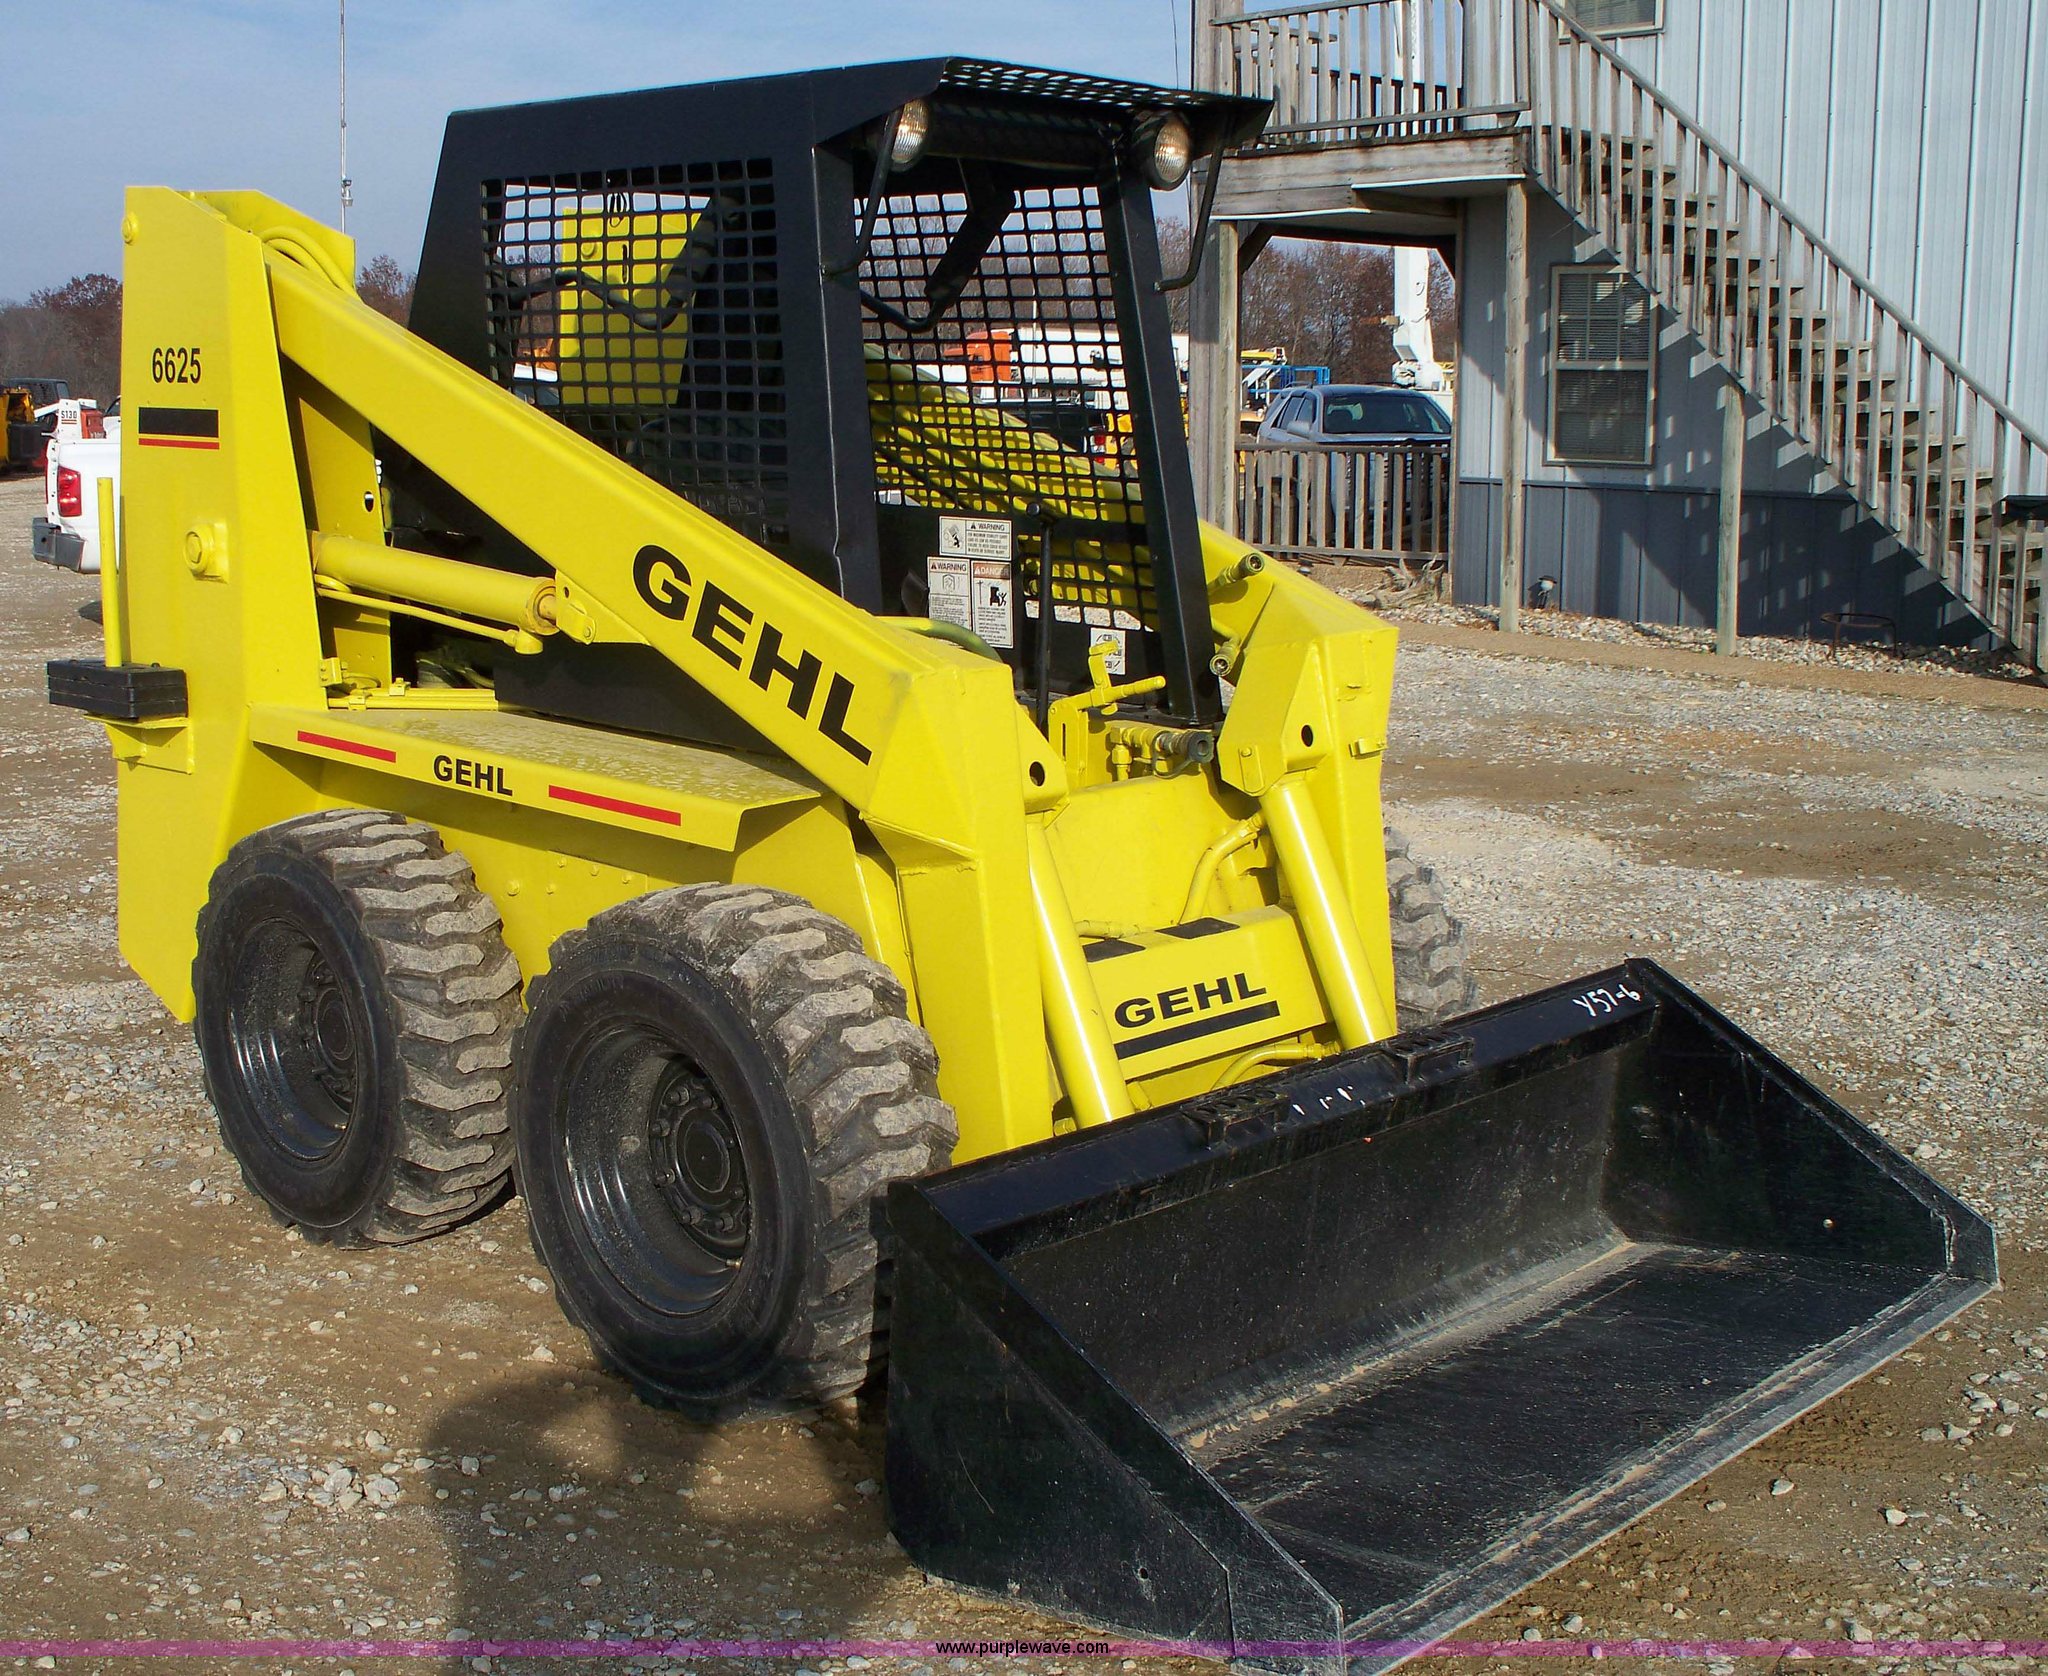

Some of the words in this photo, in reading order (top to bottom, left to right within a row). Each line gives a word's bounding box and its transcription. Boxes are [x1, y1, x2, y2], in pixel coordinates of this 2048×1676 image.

[152, 347, 201, 384] 6625
[978, 523, 1005, 531] WARNING
[938, 563, 967, 571] WARNING
[981, 566, 1009, 576] DANGER
[633, 544, 873, 766] GEHL
[433, 755, 513, 797] GEHL
[1114, 972, 1267, 1028] GEHL
